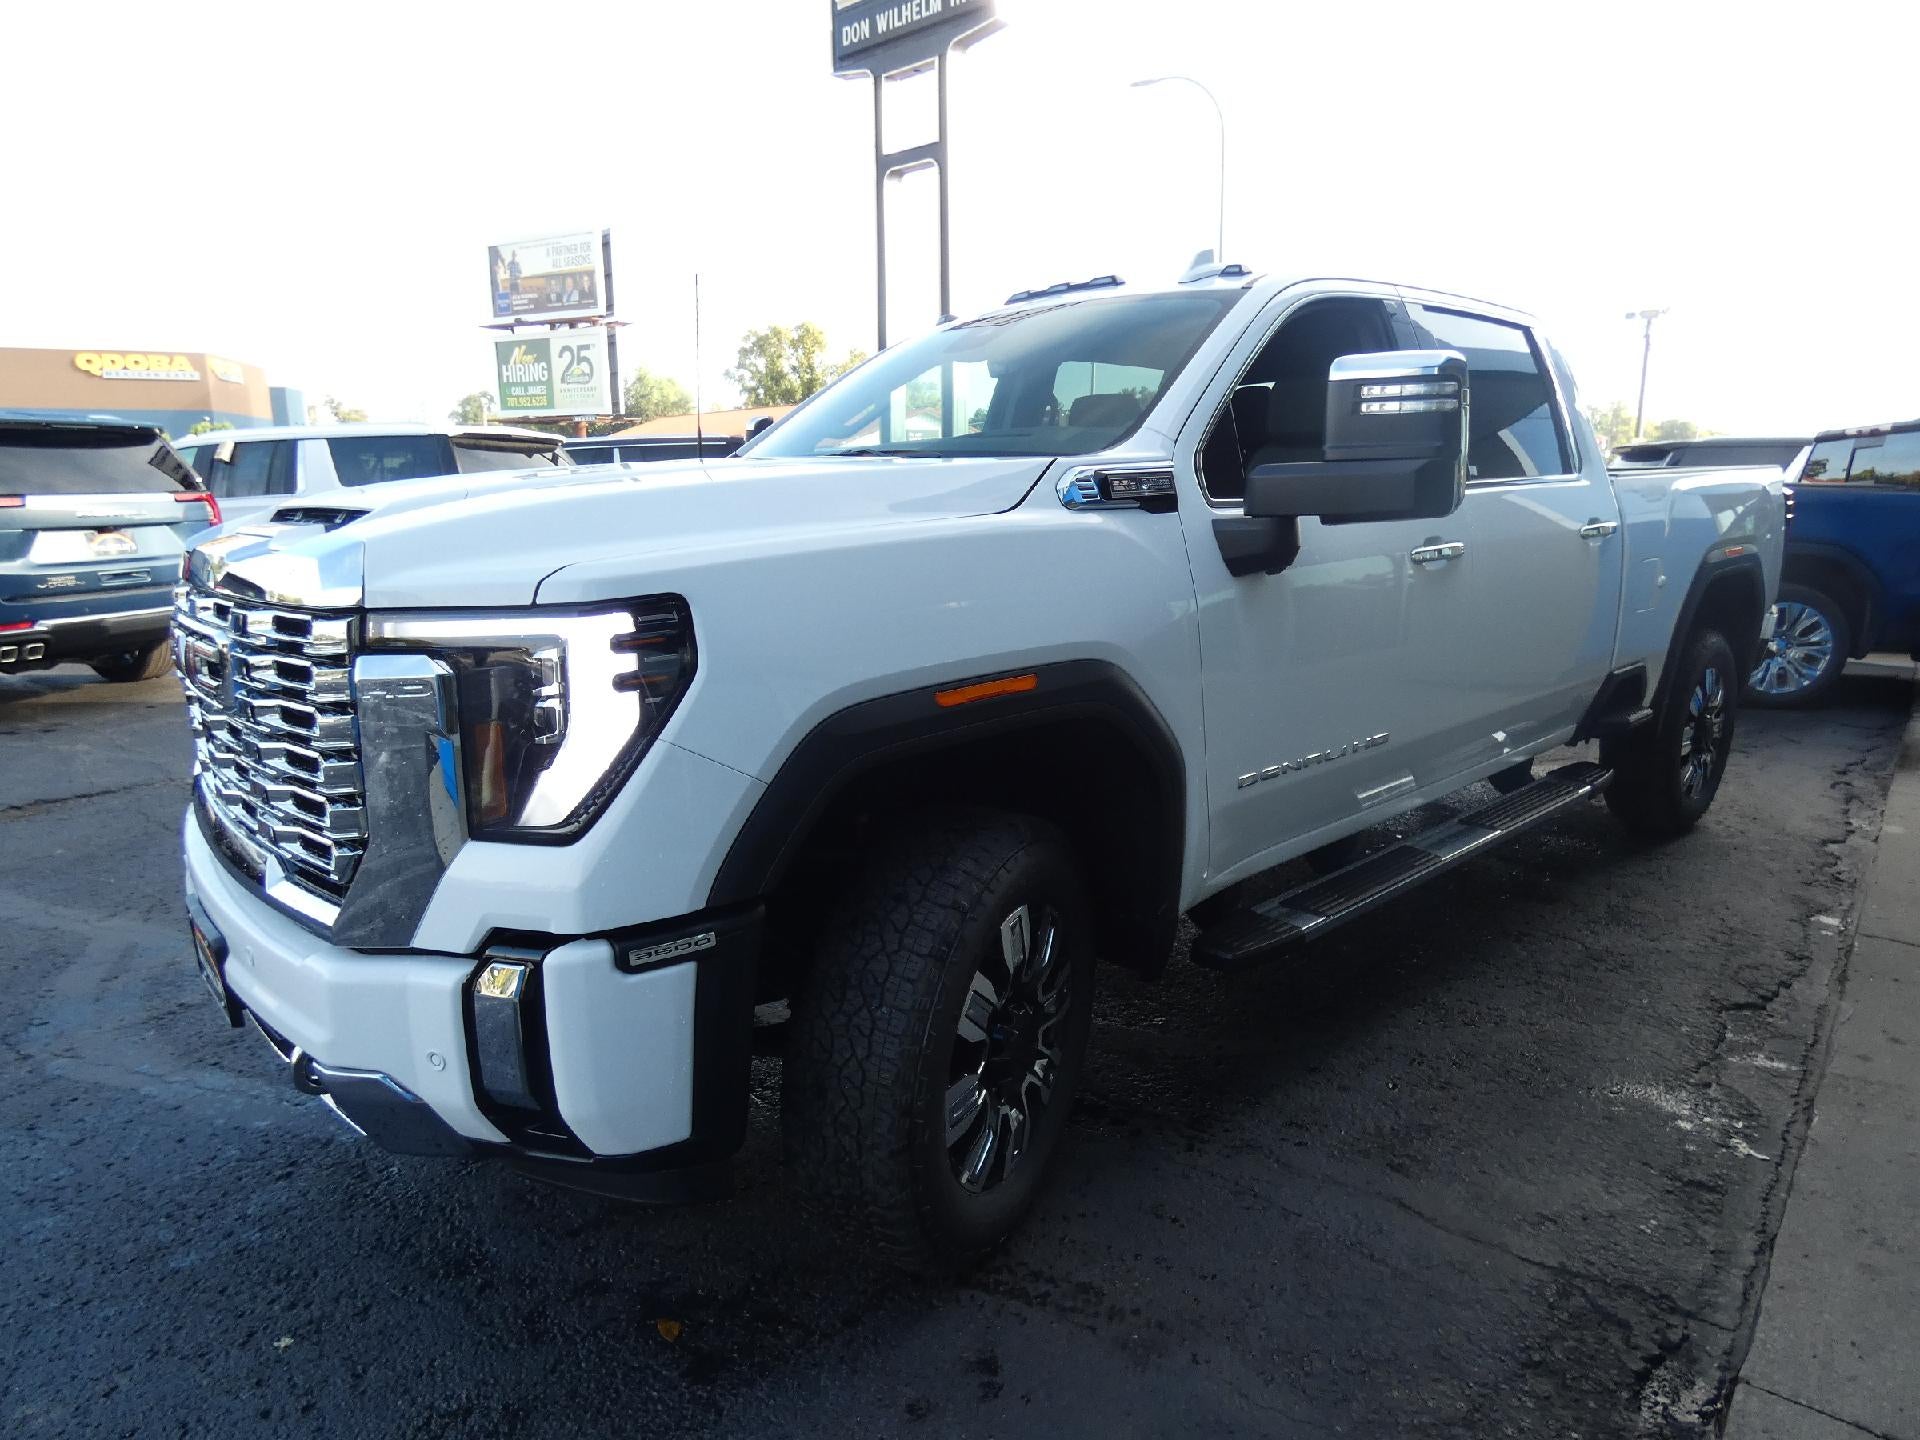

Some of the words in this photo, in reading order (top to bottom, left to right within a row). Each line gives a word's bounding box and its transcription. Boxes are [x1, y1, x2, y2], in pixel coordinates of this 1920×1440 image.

[842, 18, 870, 46] DON
[876, 0, 942, 34] WILHELM
[552, 244, 578, 257] PARTNER
[579, 241, 592, 253] FOR
[552, 258, 562, 268] ALL
[74, 352, 194, 377] QDOBA
[502, 361, 548, 383] HIRING
[558, 344, 594, 385] 25
[511, 386, 525, 396] CALL
[1353, 732, 1391, 753] HD
